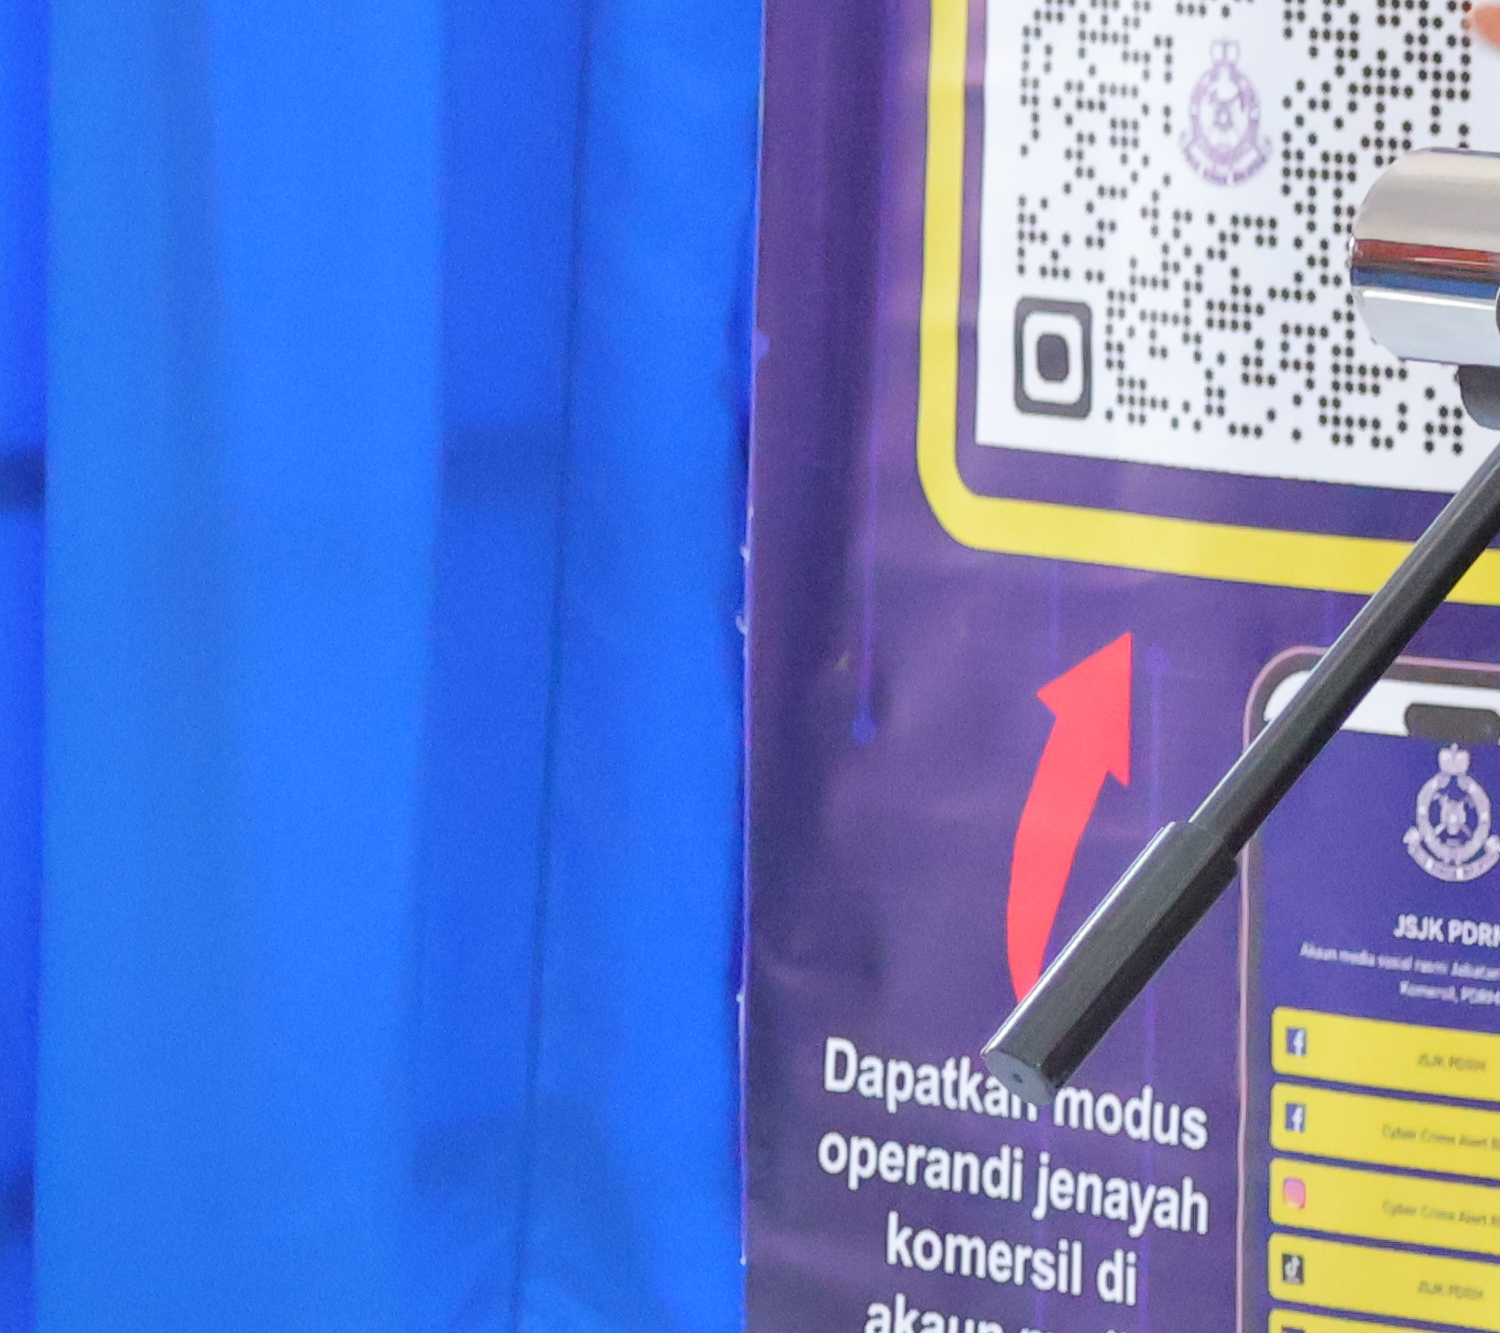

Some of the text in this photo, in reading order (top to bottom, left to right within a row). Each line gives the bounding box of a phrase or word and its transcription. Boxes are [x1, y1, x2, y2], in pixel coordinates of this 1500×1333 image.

[1393, 913, 1443, 941] JSJK
[1054, 1085, 1207, 1150] modus
[818, 1132, 1208, 1238] operandi jenayah
[886, 1211, 1136, 1306] komersil di
